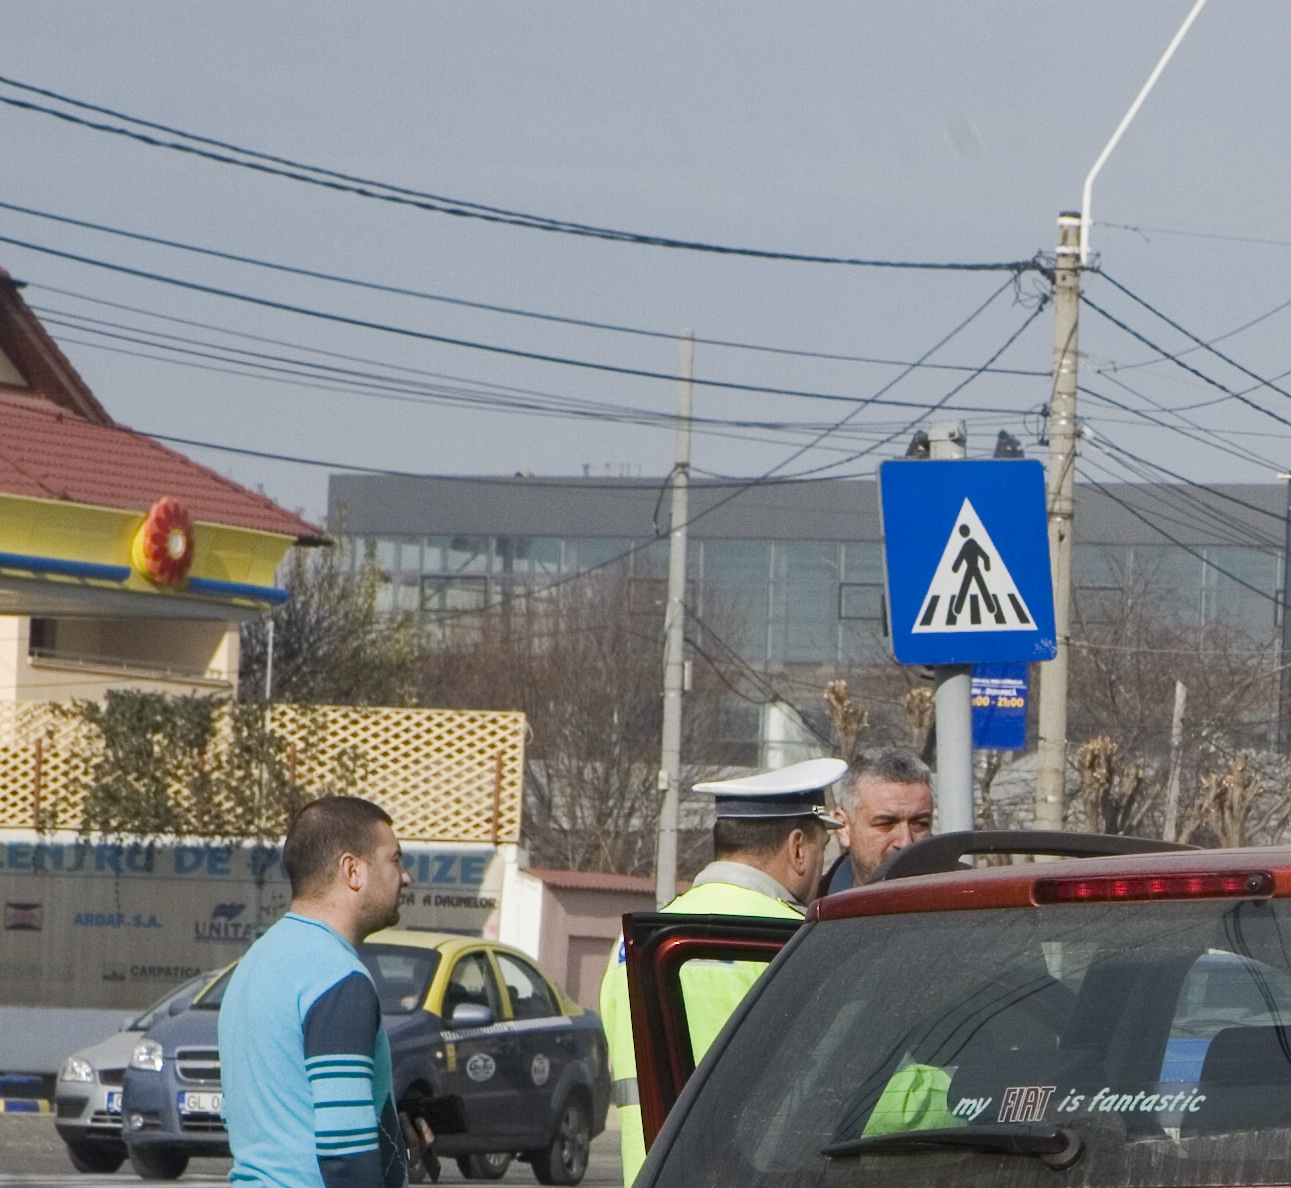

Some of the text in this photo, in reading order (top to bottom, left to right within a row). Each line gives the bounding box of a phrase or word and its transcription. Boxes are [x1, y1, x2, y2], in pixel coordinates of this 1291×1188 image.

[0, 841, 156, 875] ENTRU
[173, 845, 233, 876] DE
[187, 1096, 205, 1109] GL
[952, 1085, 1206, 1122] my FIAT is fantastic
